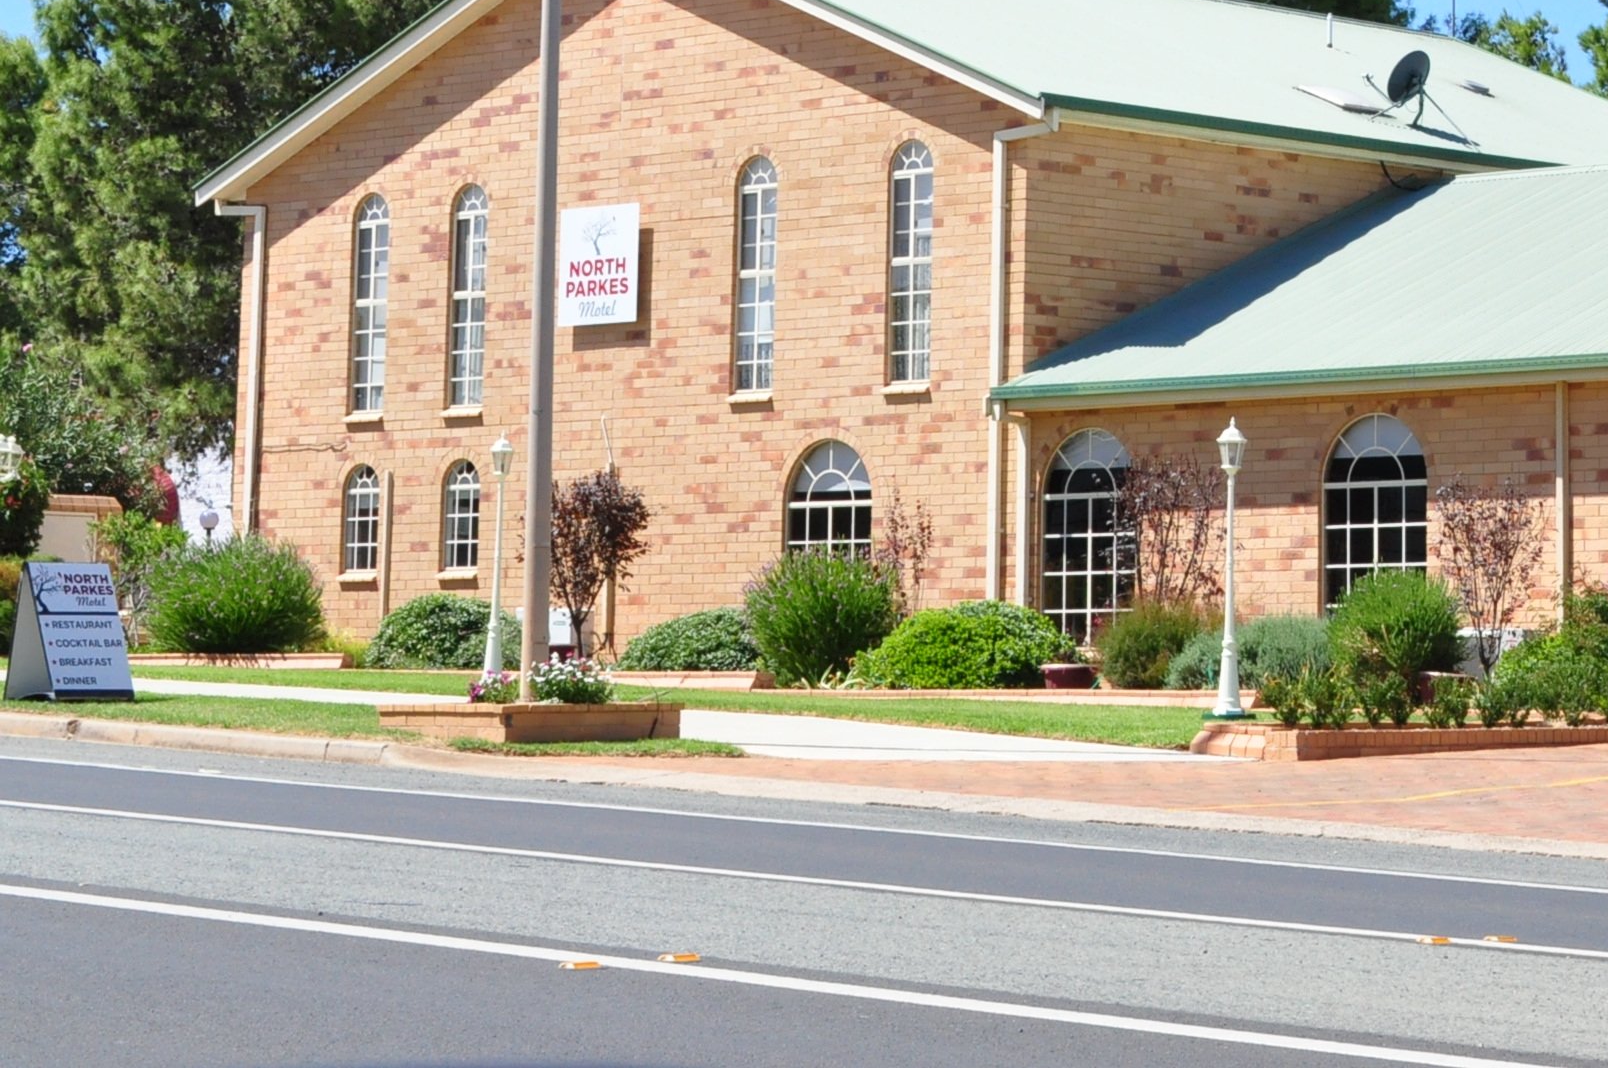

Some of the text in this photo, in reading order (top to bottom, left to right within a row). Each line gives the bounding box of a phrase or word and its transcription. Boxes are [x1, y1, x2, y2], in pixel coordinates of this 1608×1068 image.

[569, 256, 627, 278] NORTH
[565, 277, 629, 299] PARKES
[578, 299, 617, 318] Motel
[64, 573, 109, 584] NORTH
[63, 585, 114, 596] PARKES
[75, 596, 107, 607] Motel
[51, 620, 113, 629] RESTAURANT
[55, 638, 123, 648] COCKTAIL BAR
[59, 657, 113, 667] BREAKFAST
[62, 676, 98, 685] DINNER
